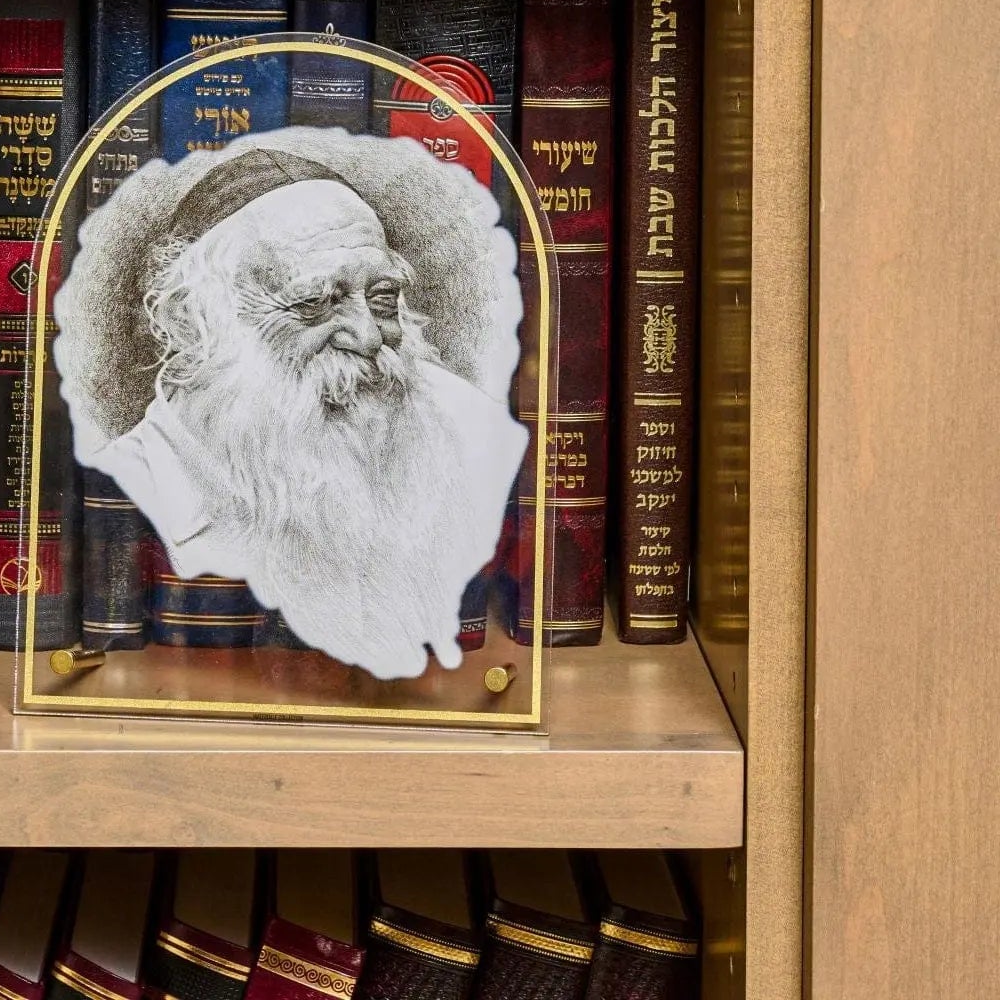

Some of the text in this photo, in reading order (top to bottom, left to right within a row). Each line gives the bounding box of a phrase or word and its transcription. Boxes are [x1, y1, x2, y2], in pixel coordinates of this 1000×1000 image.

[639, 76, 677, 173] הלכות
[423, 137, 459, 160] ספר
[533, 140, 597, 173] שיעורי
[538, 186, 591, 211] חומש
[648, 186, 675, 257] שבת
[640, 422, 675, 437] וספר
[637, 446, 677, 463] חיזוק
[636, 494, 676, 511] יעקב
[641, 526, 671, 538] קיצור
[664, 562, 680, 575] למי
